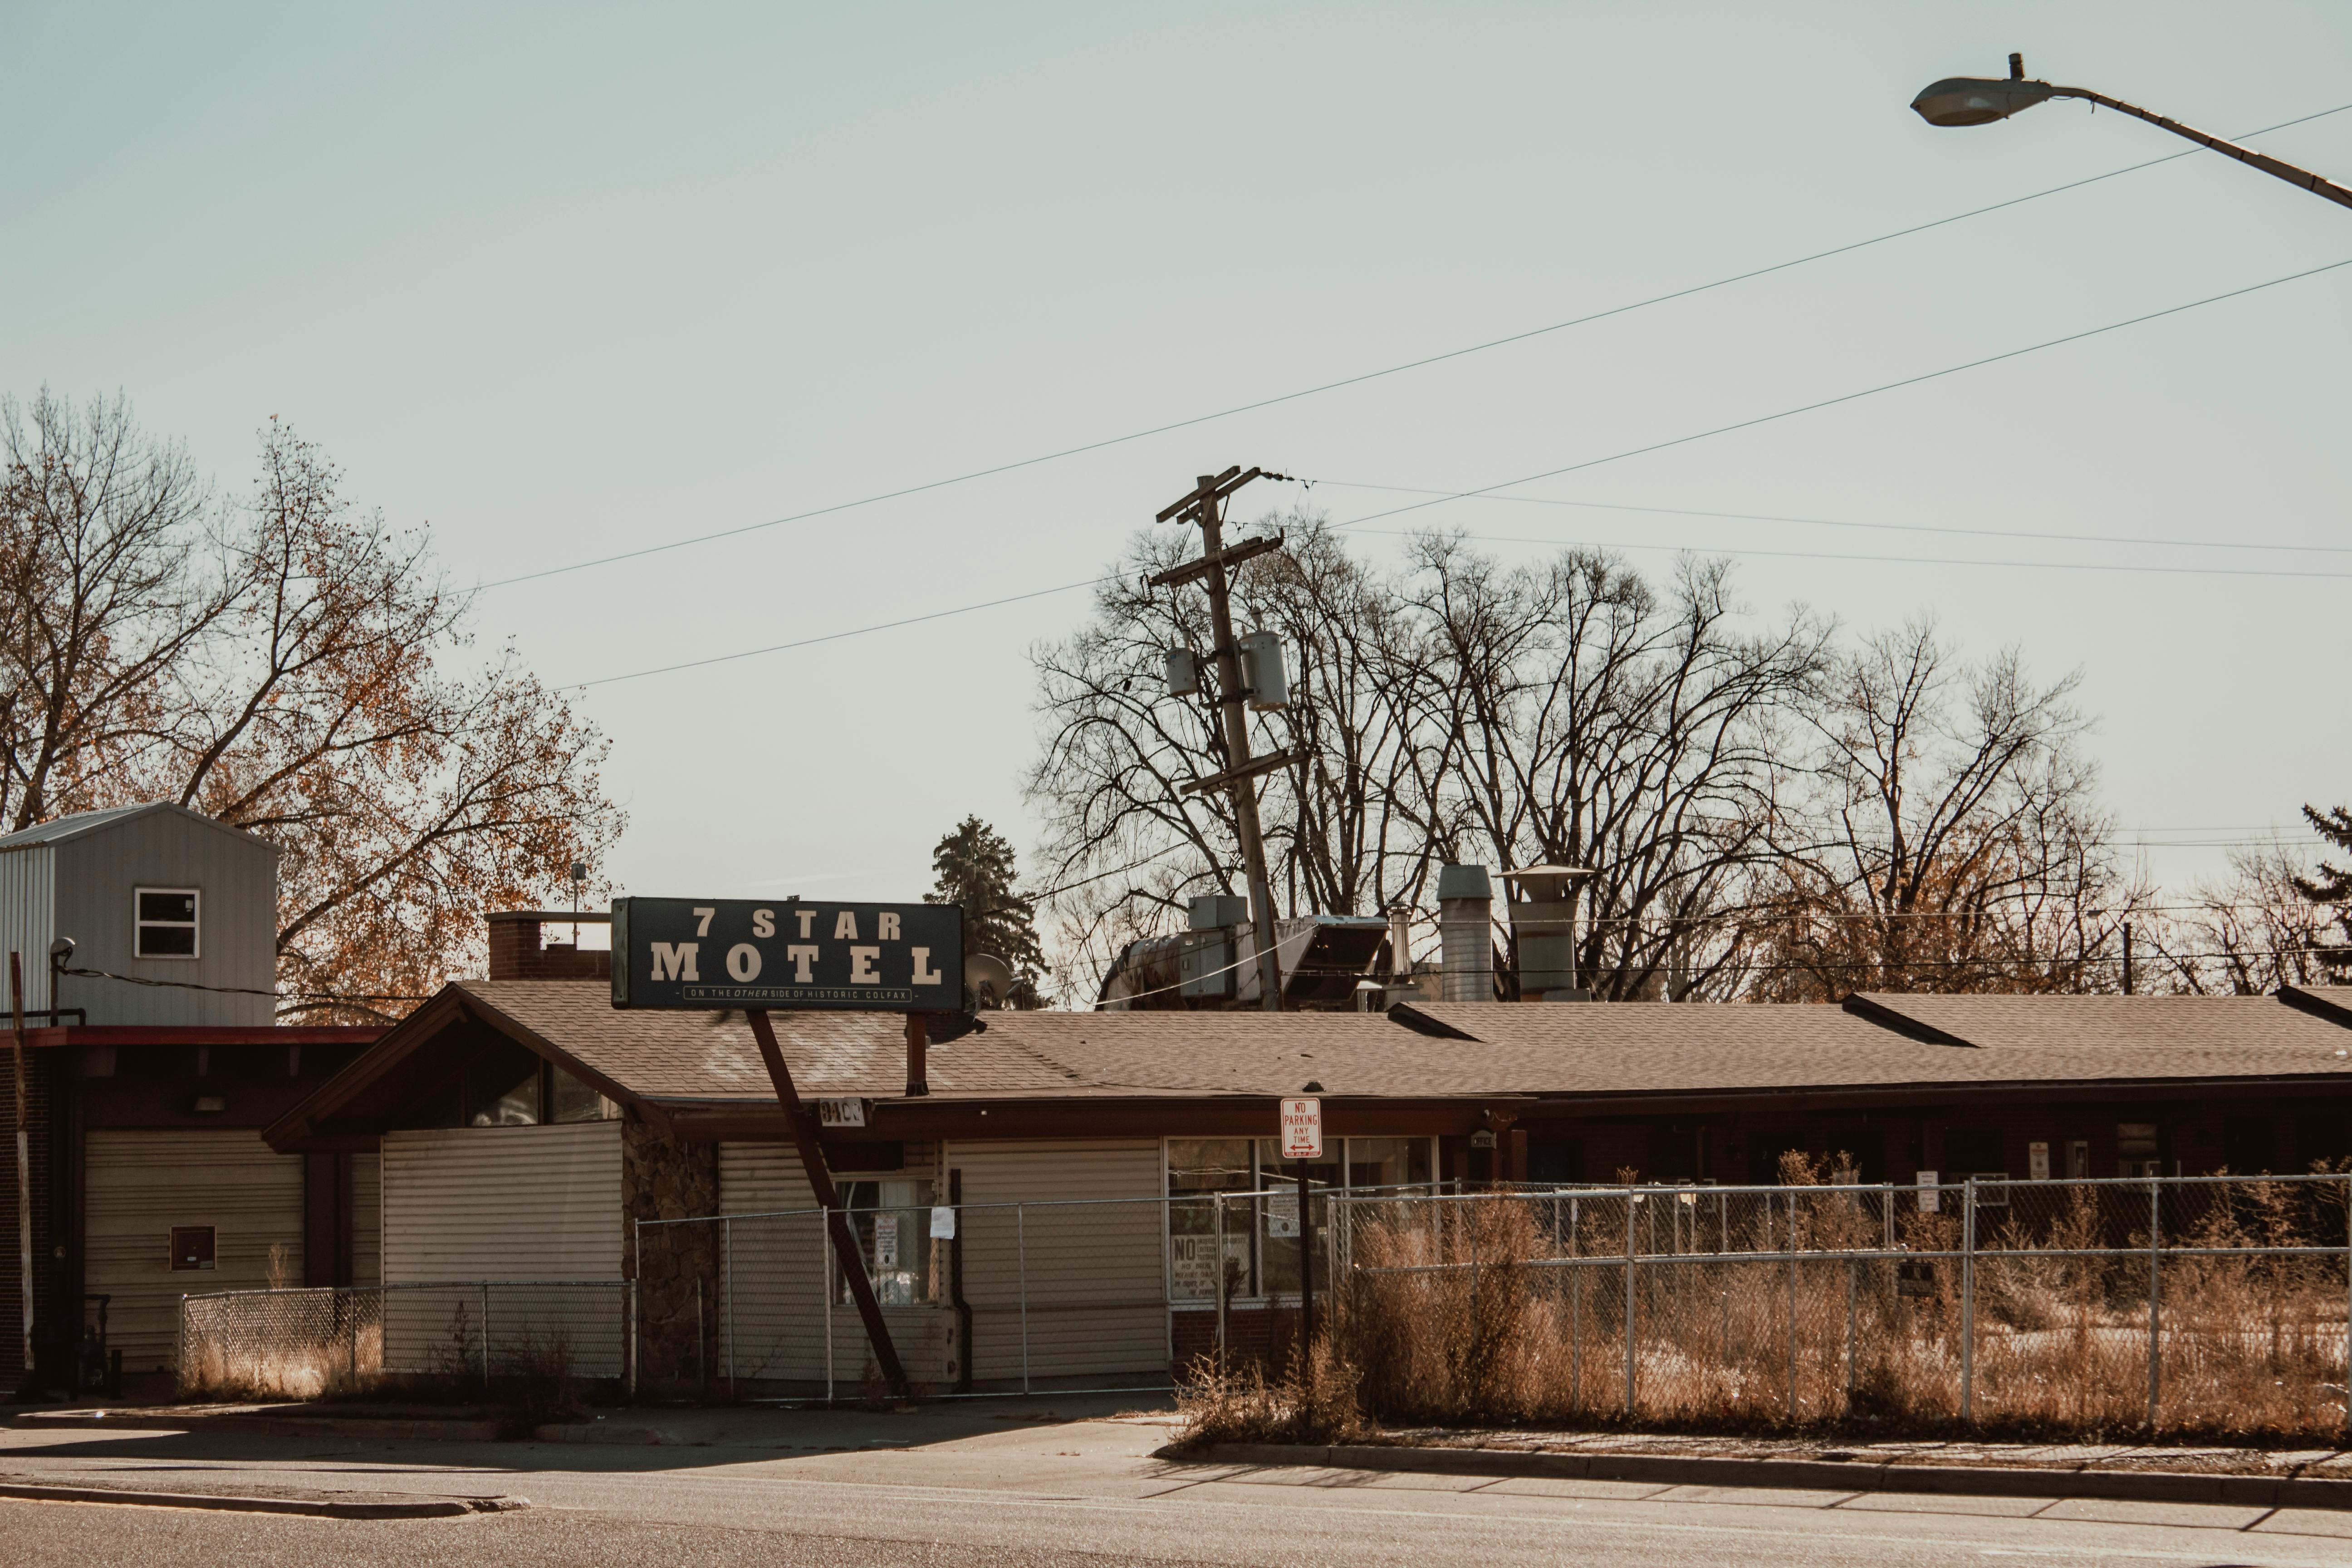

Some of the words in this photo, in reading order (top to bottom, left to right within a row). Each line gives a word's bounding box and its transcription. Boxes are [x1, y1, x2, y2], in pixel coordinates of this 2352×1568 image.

[693, 907, 715, 937] 7
[752, 908, 901, 940] STAR
[651, 942, 941, 985] MOTEL
[1295, 1102, 1306, 1113] NO
[1284, 1114, 1318, 1126] PARKING
[1293, 1136, 1310, 1144] TIME
[1473, 1137, 1492, 1146] OFFICE
[1174, 1238, 1196, 1261] NO
